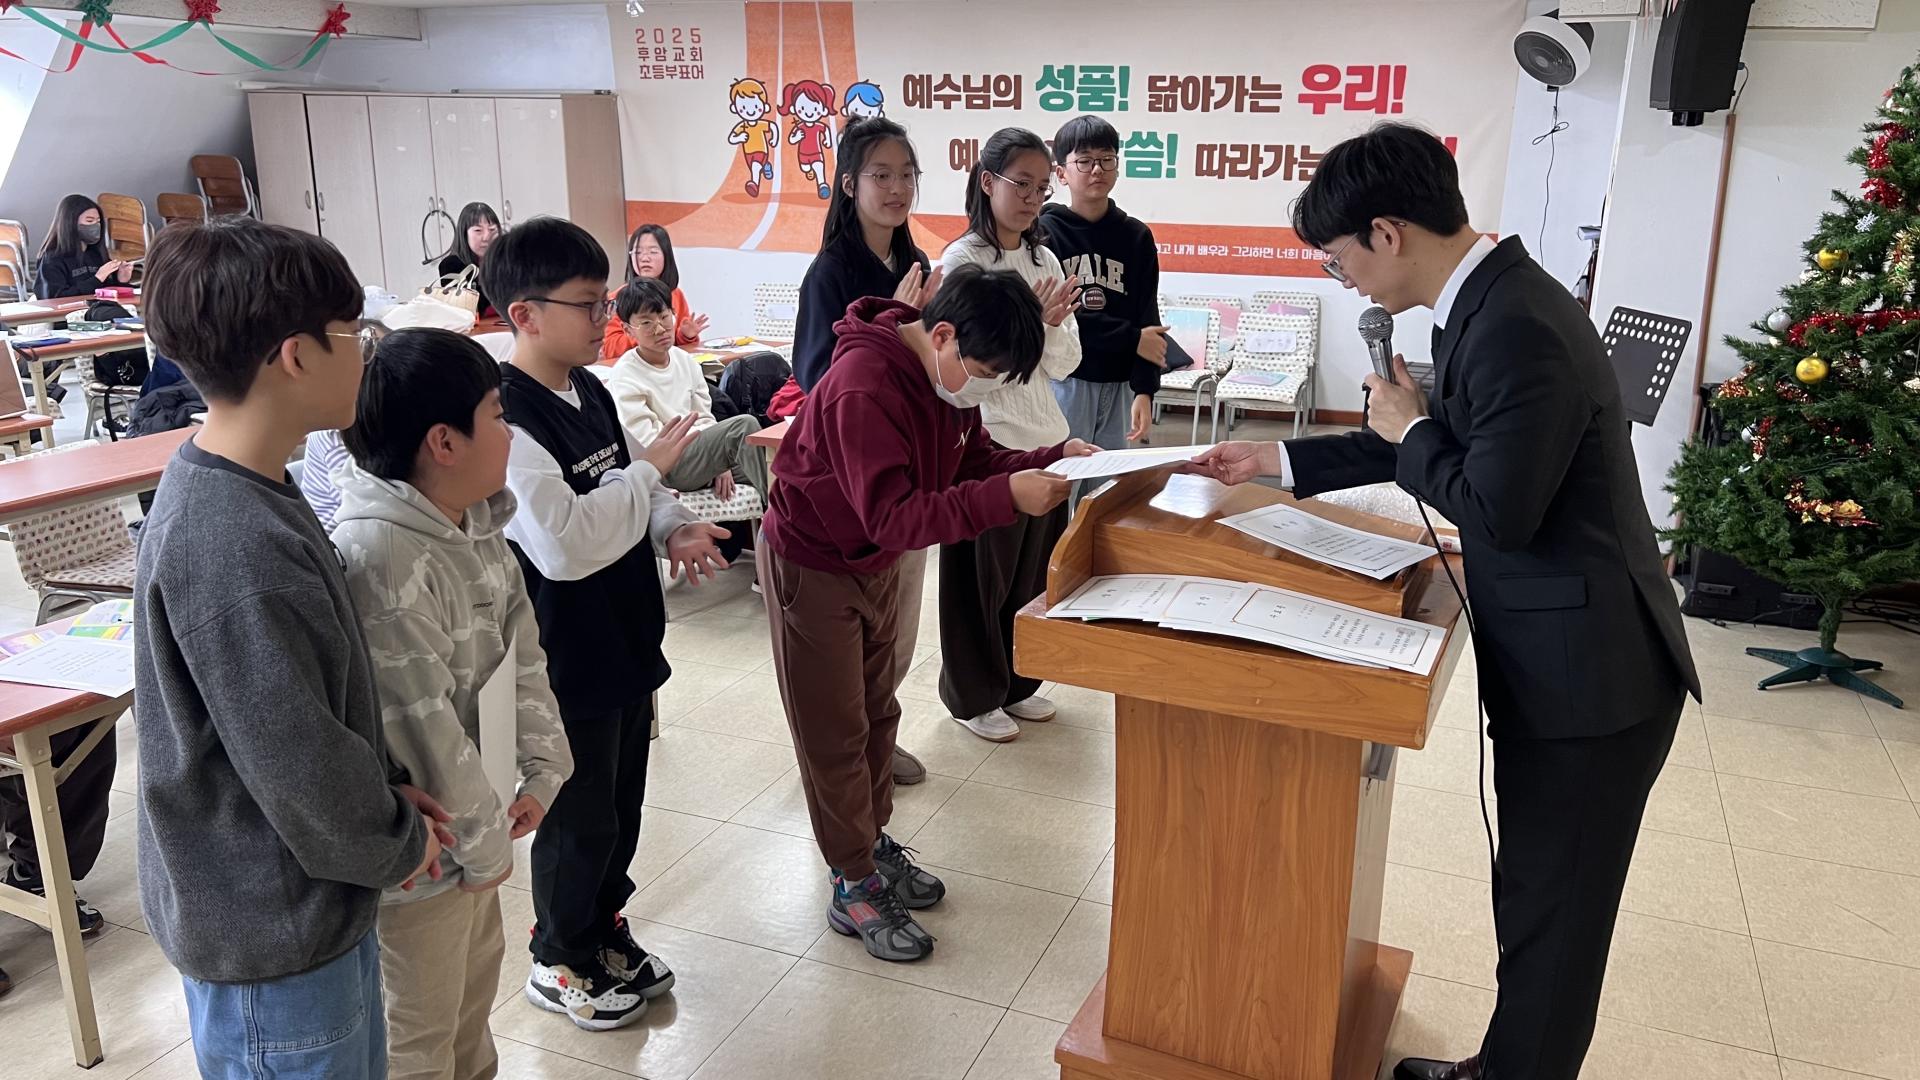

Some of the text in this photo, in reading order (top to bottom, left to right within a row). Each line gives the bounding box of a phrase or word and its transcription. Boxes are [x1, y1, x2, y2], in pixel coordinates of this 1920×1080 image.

[635, 28, 702, 44] 2025
[637, 46, 703, 62] 후암교회
[639, 64, 705, 80] 초등부표어
[902, 64, 1407, 114] 예수님의 성품! 닮아가는 우리!
[1118, 130, 1178, 178] 씀!
[1173, 243, 1195, 256] 내게
[1197, 244, 1229, 257] 배우라
[1231, 245, 1274, 259] 그리하면
[1276, 247, 1299, 260] 너희
[1062, 253, 1125, 293] YALE
